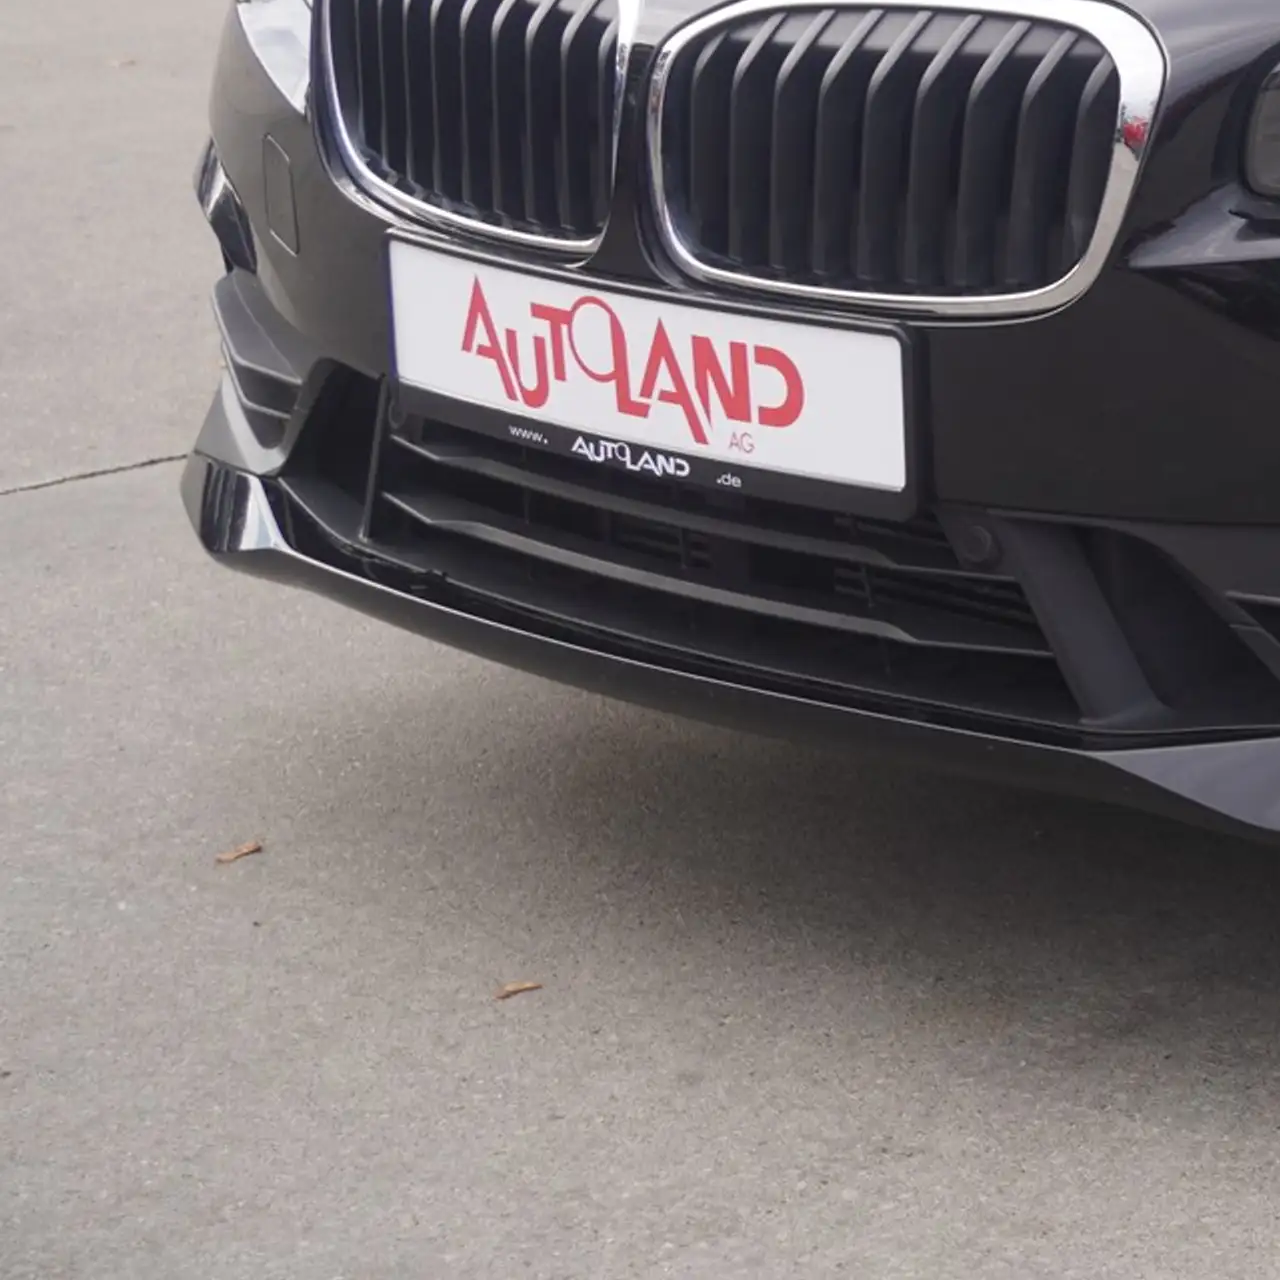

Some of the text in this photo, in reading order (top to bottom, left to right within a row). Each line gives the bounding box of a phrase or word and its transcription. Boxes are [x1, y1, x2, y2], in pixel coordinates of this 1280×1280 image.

[461, 274, 805, 446] AUTOLAND
[508, 424, 742, 488] www. AUTOLAND .de
[729, 431, 756, 454] AG
